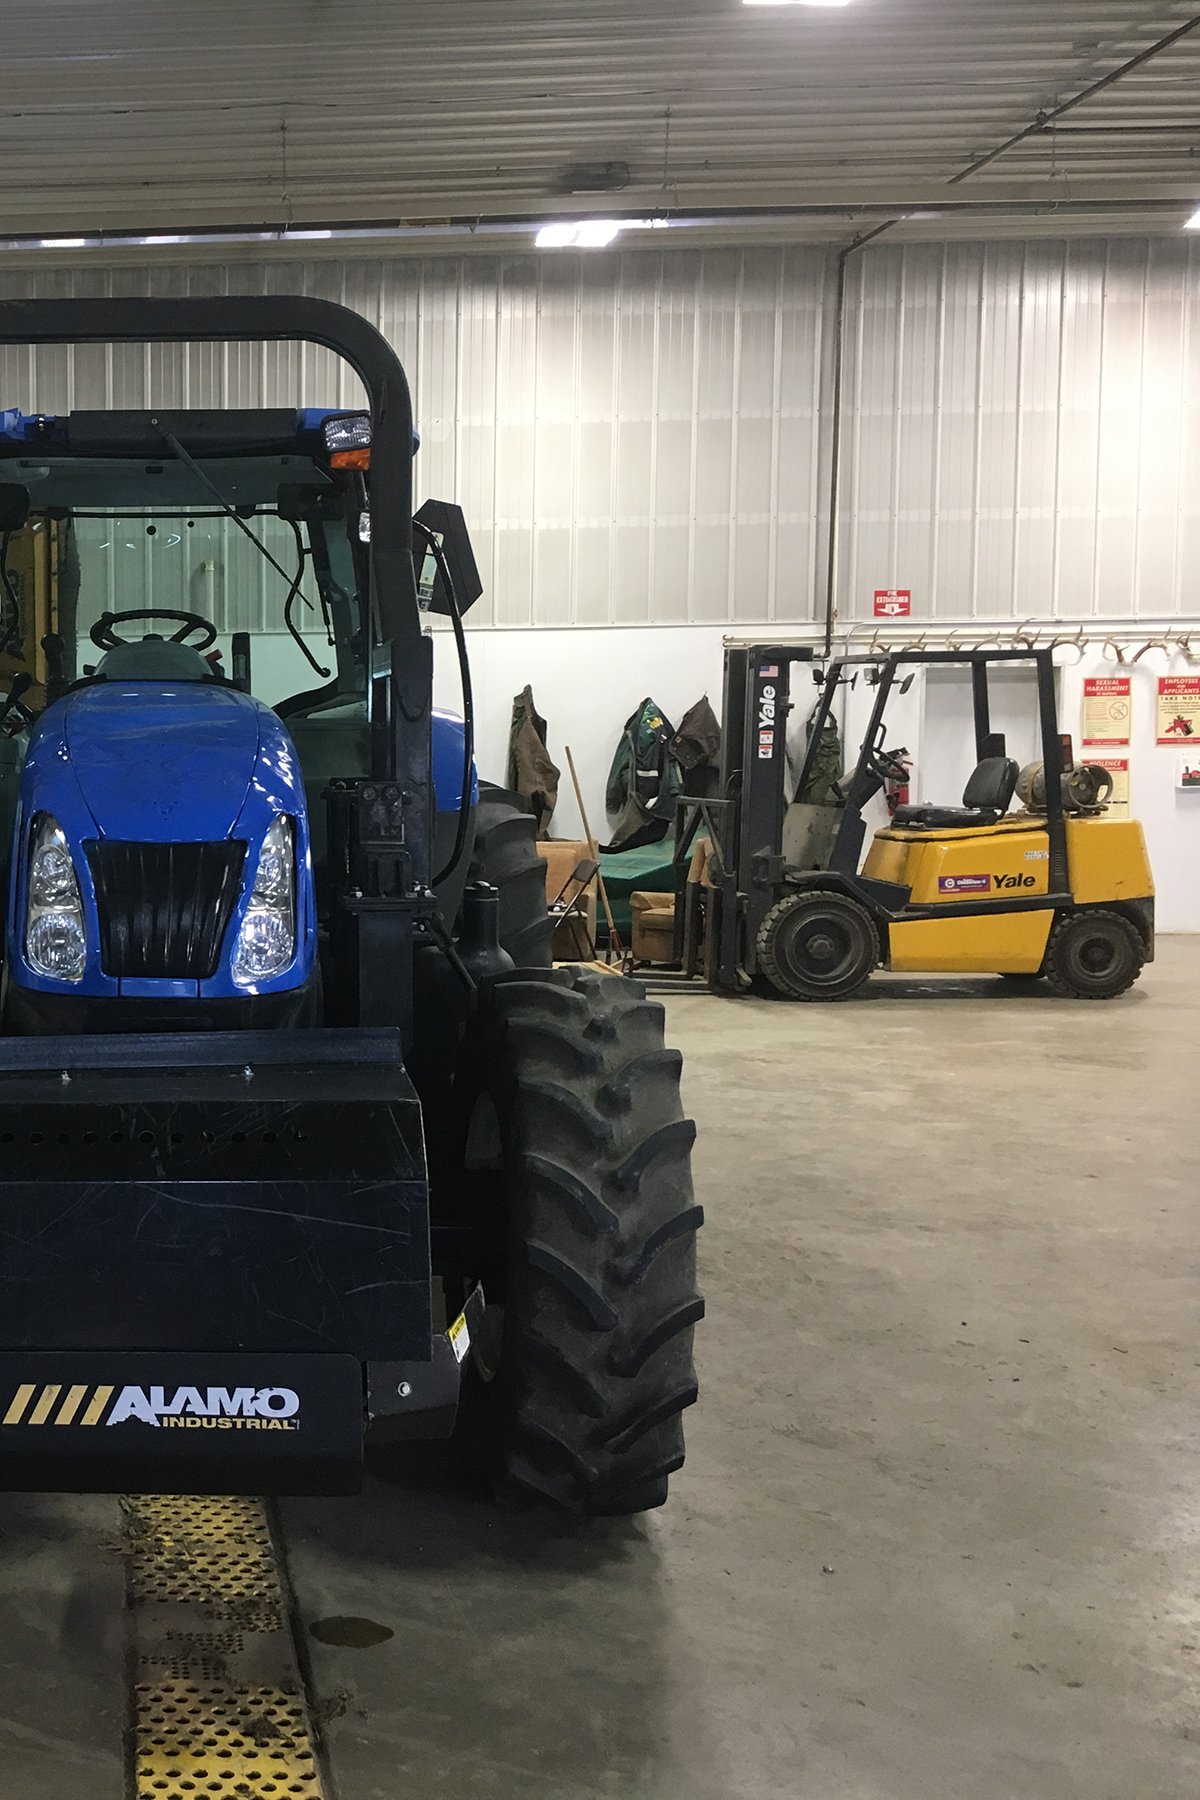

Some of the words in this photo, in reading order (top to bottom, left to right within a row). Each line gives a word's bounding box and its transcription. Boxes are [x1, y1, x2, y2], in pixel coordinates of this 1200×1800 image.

[758, 685, 776, 729] Yale
[993, 873, 1036, 888] Yale
[105, 1385, 300, 1427] ALAMO
[162, 1416, 295, 1431] INDUSTRIAL
